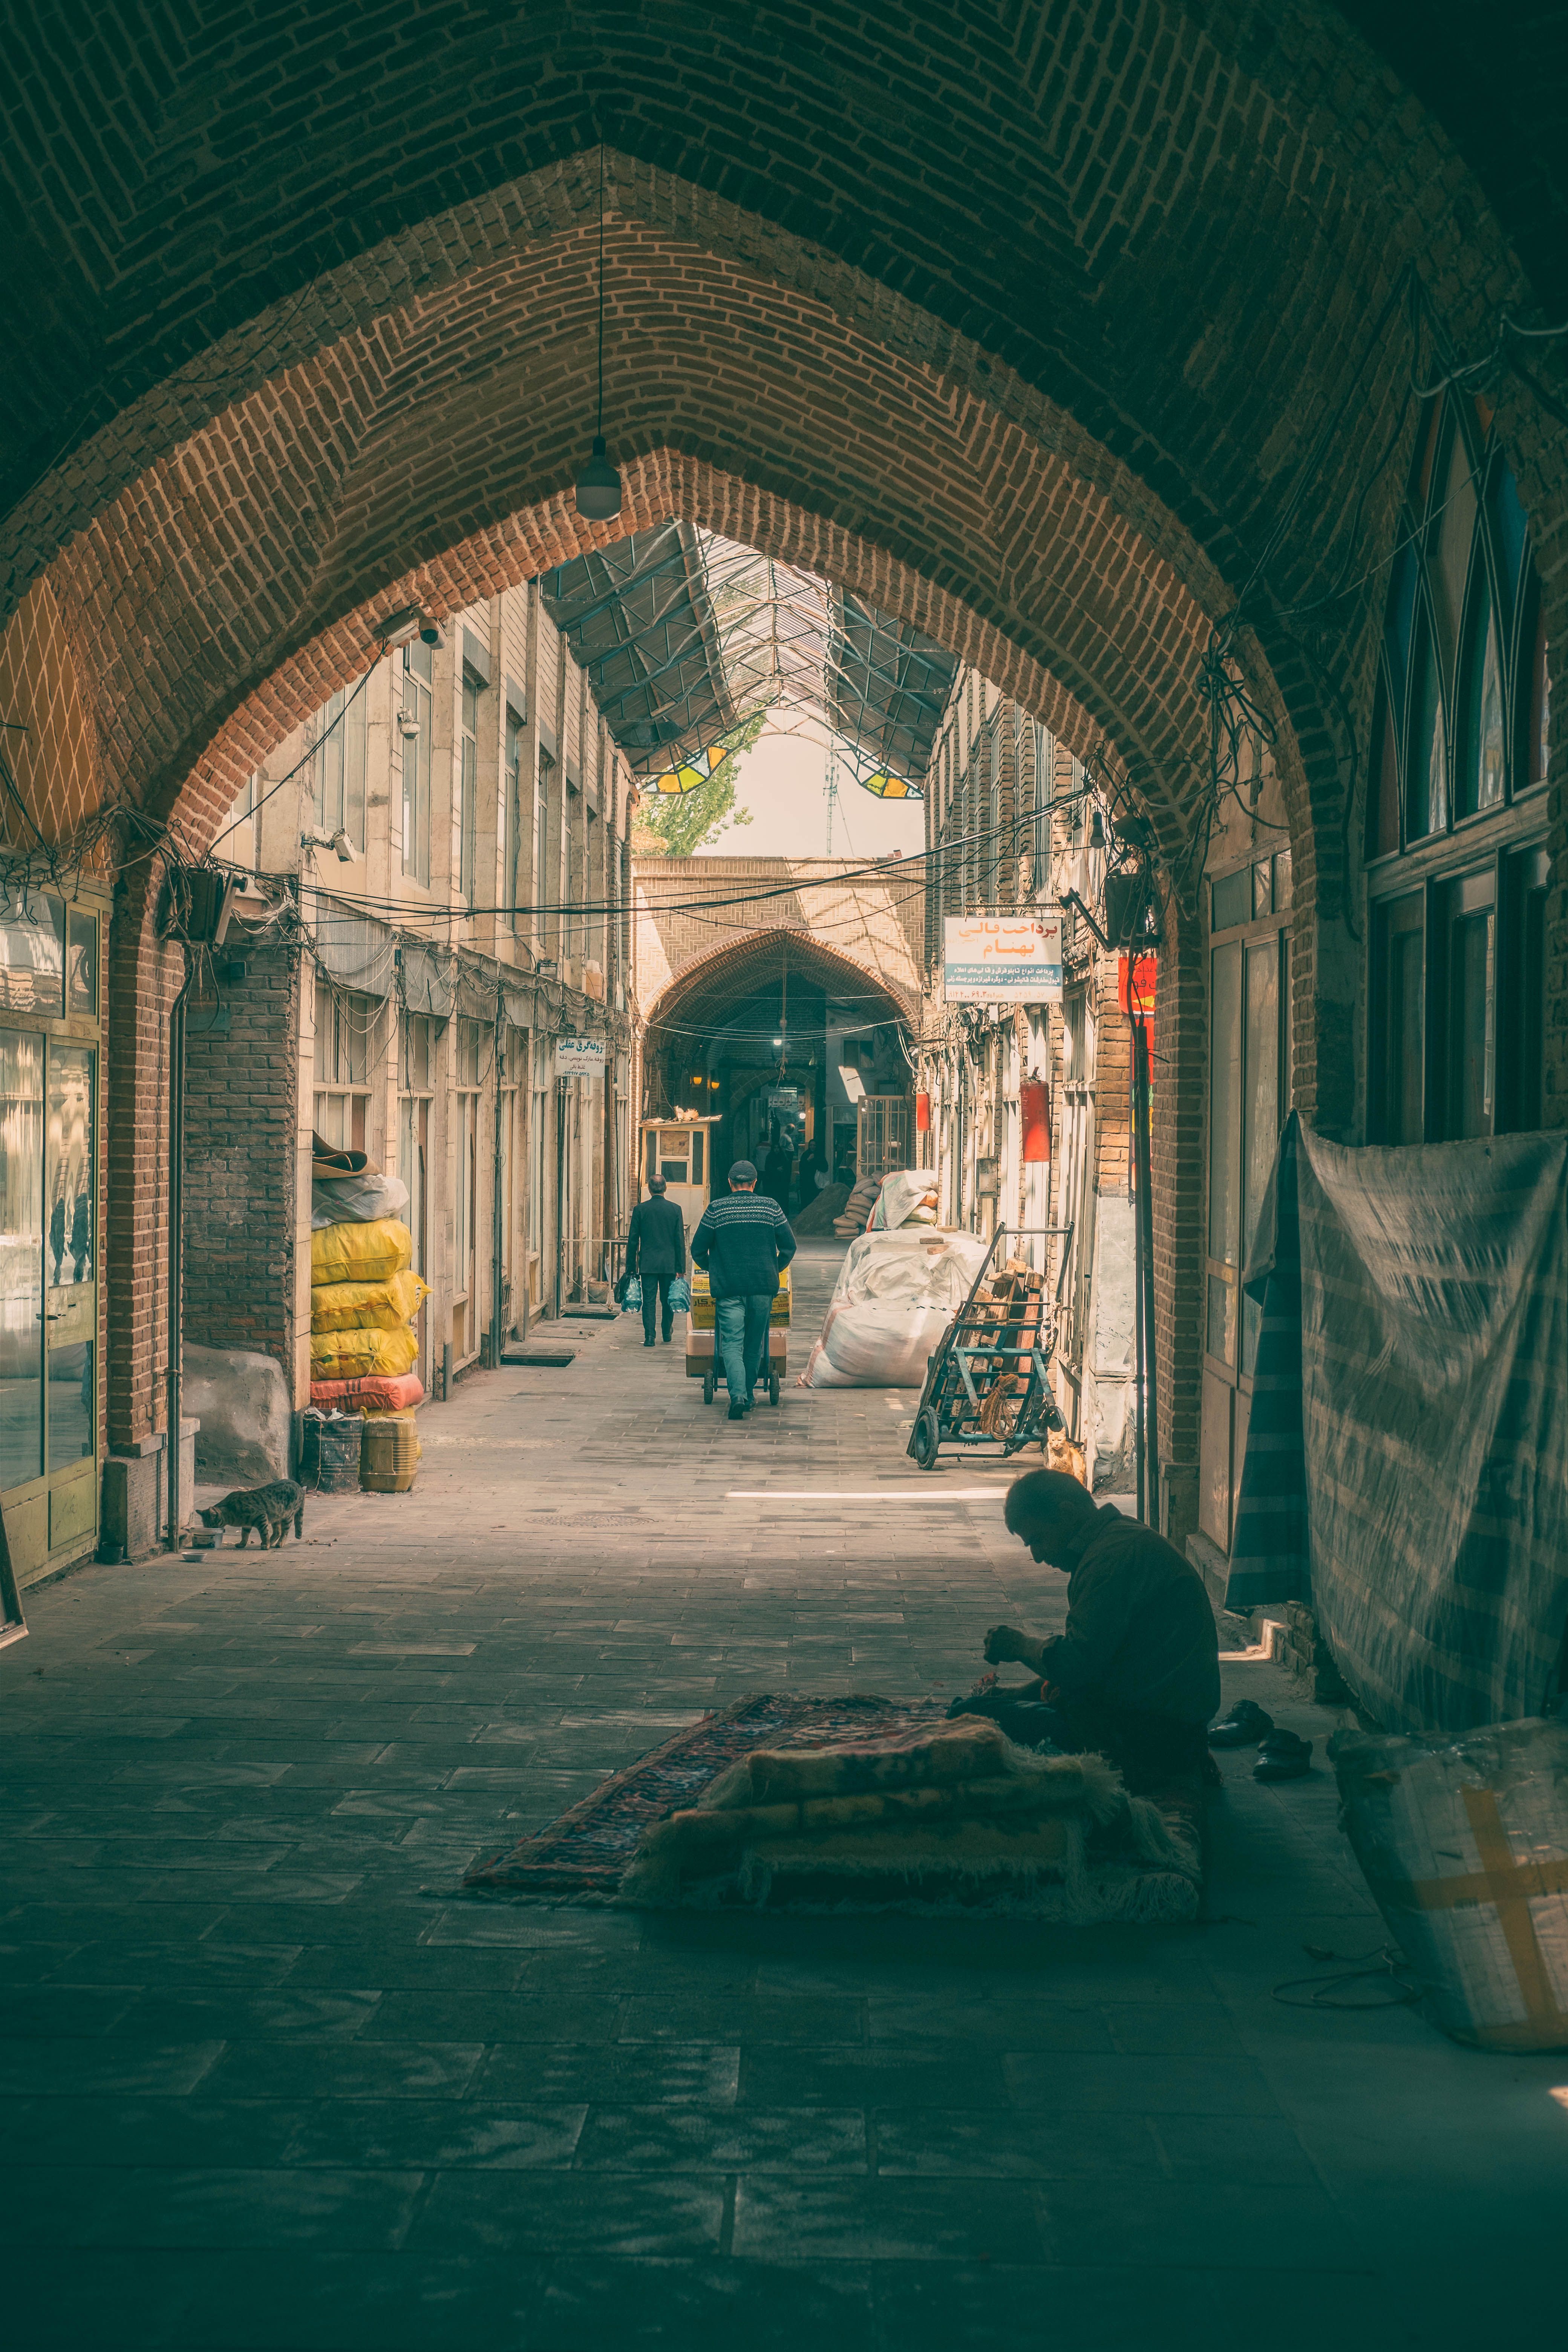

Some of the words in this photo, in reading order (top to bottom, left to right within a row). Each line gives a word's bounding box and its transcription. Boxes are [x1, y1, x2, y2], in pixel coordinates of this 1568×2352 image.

[959, 920, 1000, 937] قالی
[1003, 922, 1058, 939] پرداخت
[983, 938, 1035, 959] بهنام
[1036, 968, 1054, 977] پرداخت
